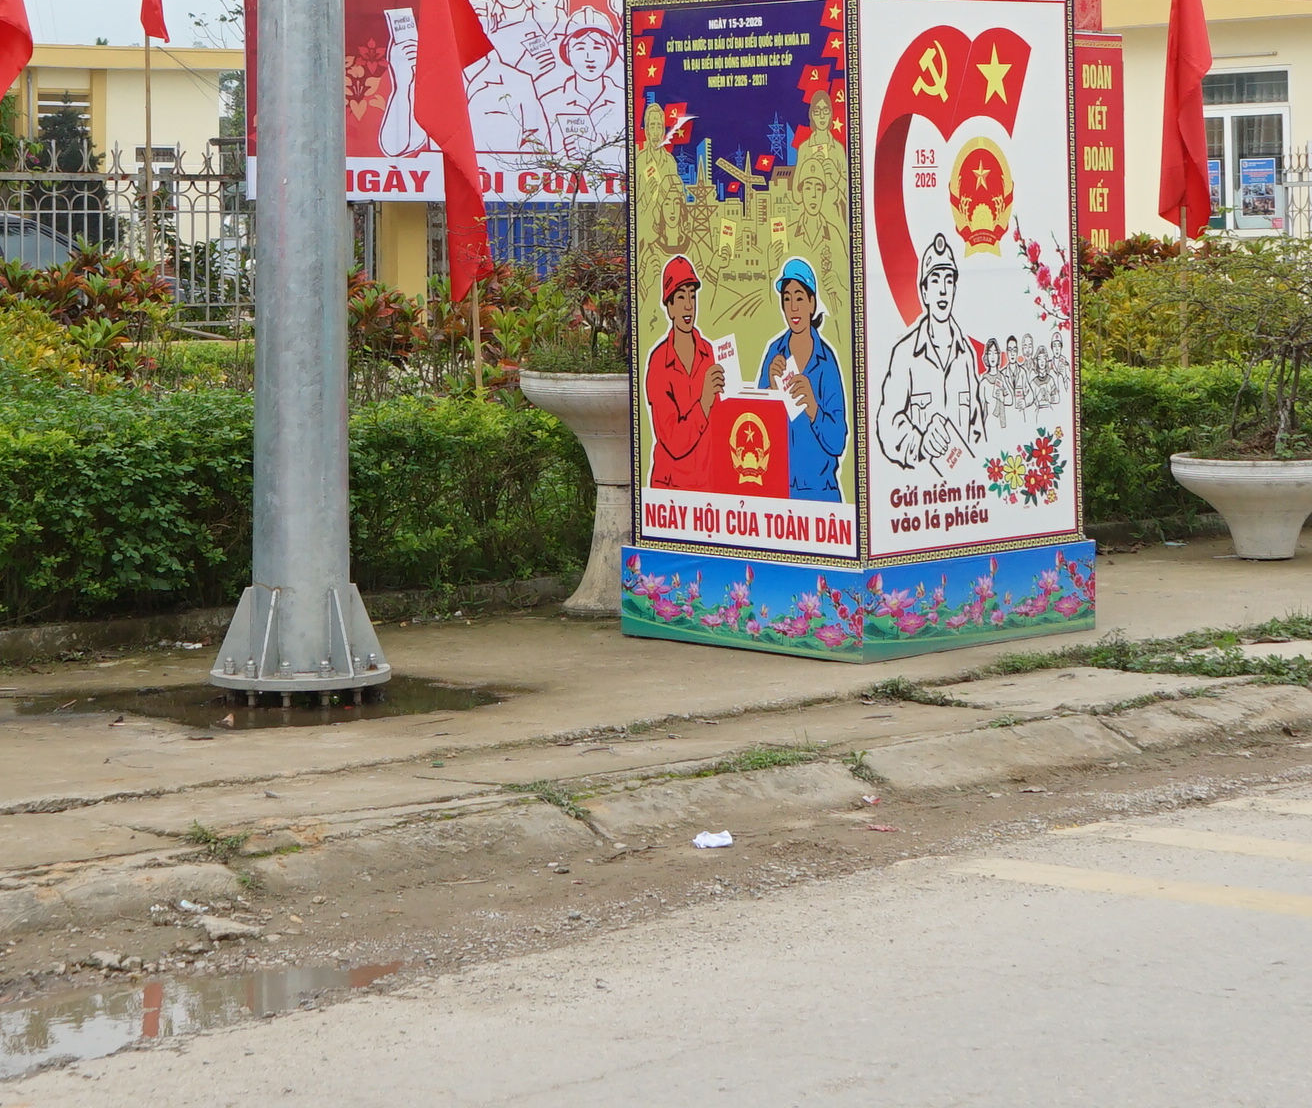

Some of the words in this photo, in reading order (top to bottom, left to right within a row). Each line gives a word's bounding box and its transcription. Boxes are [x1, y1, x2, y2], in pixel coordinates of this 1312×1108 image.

[709, 17, 726, 30] NGÀY
[729, 17, 762, 28] 15-3-2026
[1082, 60, 1112, 90] ĐOÀN
[1088, 97, 1107, 130] KẾT
[915, 149, 935, 164] 15-3
[1084, 141, 1113, 171] ĐOÀN
[915, 173, 936, 188] 2026
[1090, 179, 1108, 212] KẾT
[891, 484, 918, 508] Gửi
[923, 480, 962, 505] niềm
[966, 480, 986, 500] tin
[645, 500, 688, 529] NGÀY
[694, 503, 720, 538] HỘI
[726, 500, 759, 537] CỦA
[765, 507, 810, 542] TOÀN
[816, 513, 851, 545] DÂN
[891, 512, 920, 533] vào
[925, 506, 940, 529] lá
[945, 501, 989, 531] phiếu
